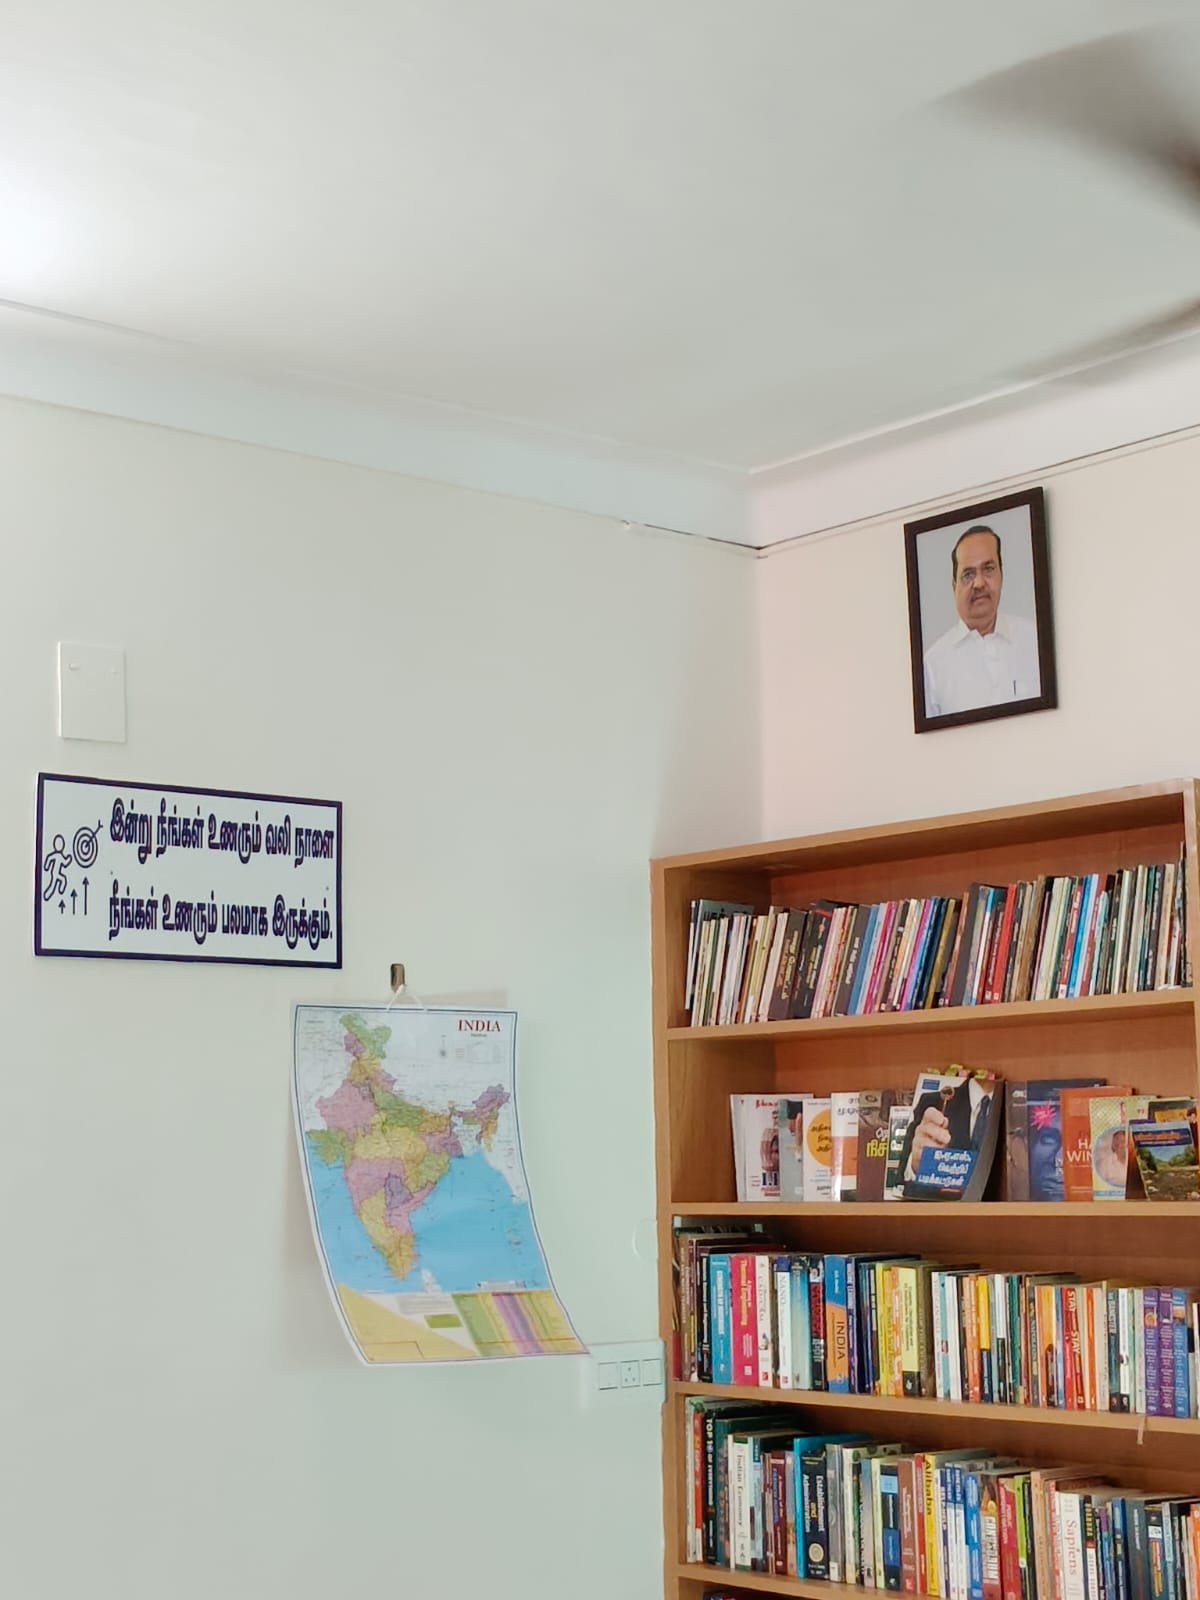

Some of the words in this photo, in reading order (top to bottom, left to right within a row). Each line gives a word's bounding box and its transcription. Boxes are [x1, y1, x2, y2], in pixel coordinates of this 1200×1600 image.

[110, 798, 152, 864] இன்று
[156, 798, 204, 857] நீங்கள்
[208, 811, 262, 864] உணரும்
[265, 814, 291, 856] வலி
[295, 826, 334, 868] நாளை
[109, 879, 158, 940] நீங்கள்
[162, 890, 217, 944] உணரும்
[222, 903, 268, 937] பலமாக
[458, 1019, 501, 1032] INDIA
[1067, 1291, 1075, 1312] STAY
[836, 1321, 845, 1360] INDIA
[1071, 1331, 1080, 1353] STAY
[736, 1454, 744, 1482] Indian
[925, 1461, 933, 1516] Alibaba
[802, 1474, 811, 1533] Administration
[816, 1475, 825, 1532] Establishment
[1064, 1520, 1079, 1576] Sapiens
